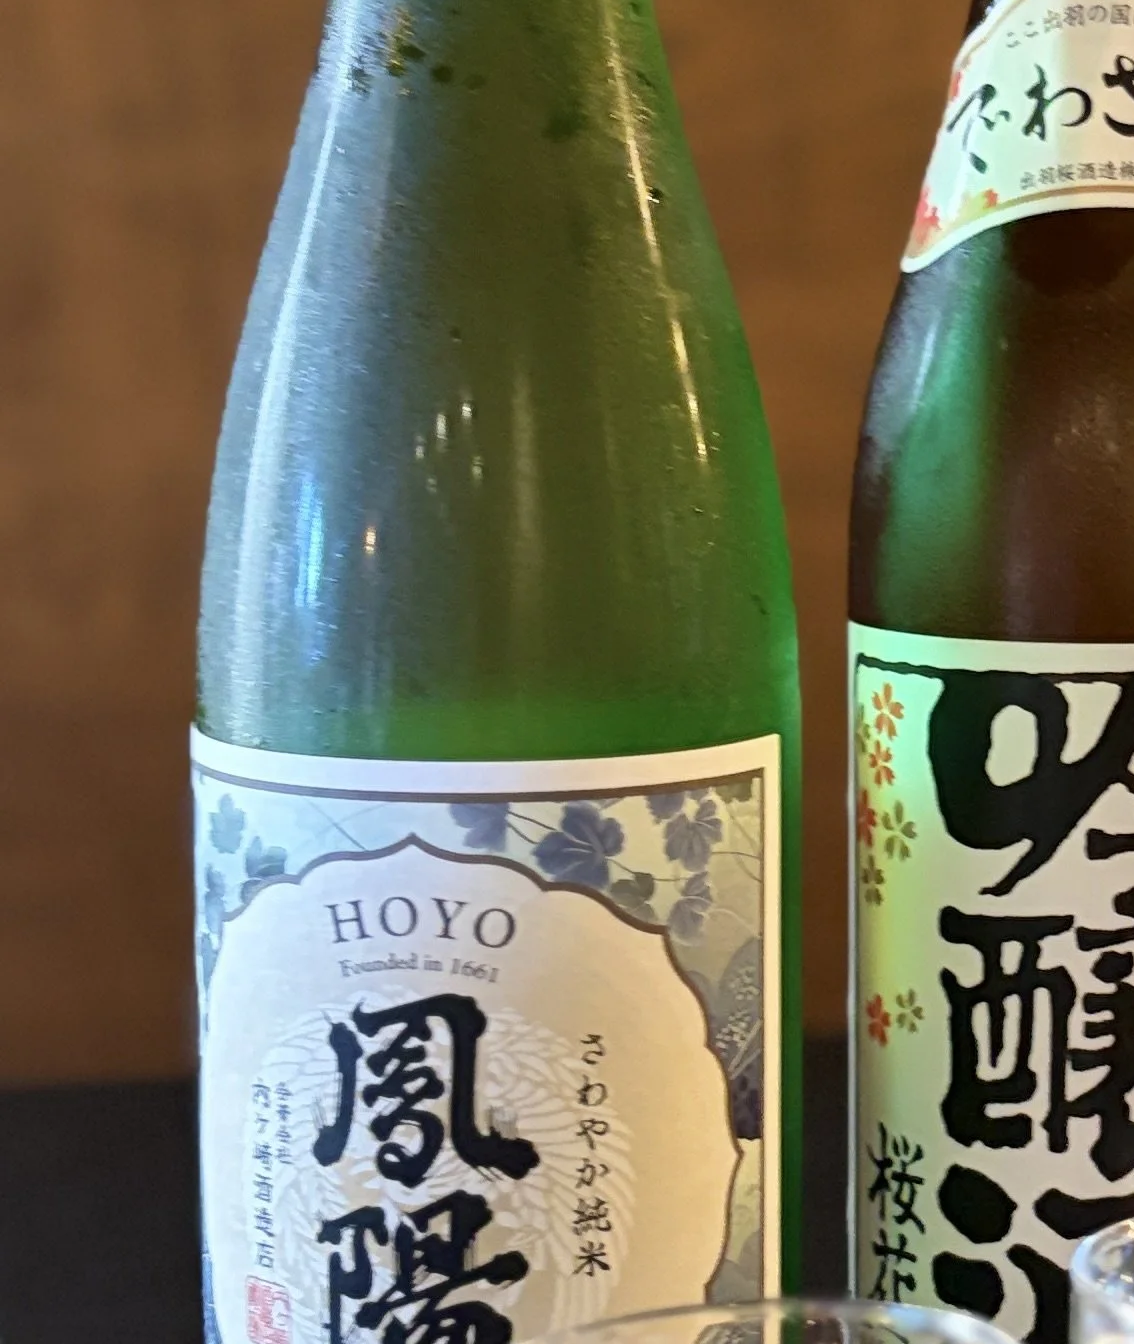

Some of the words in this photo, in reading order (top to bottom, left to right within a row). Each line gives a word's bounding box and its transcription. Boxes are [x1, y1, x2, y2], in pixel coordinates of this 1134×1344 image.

[324, 896, 516, 949] HOYO
[338, 952, 419, 978] Founded
[424, 954, 443, 972] in
[451, 958, 500, 983] 1661
[573, 1033, 612, 1277] さわやか純米
